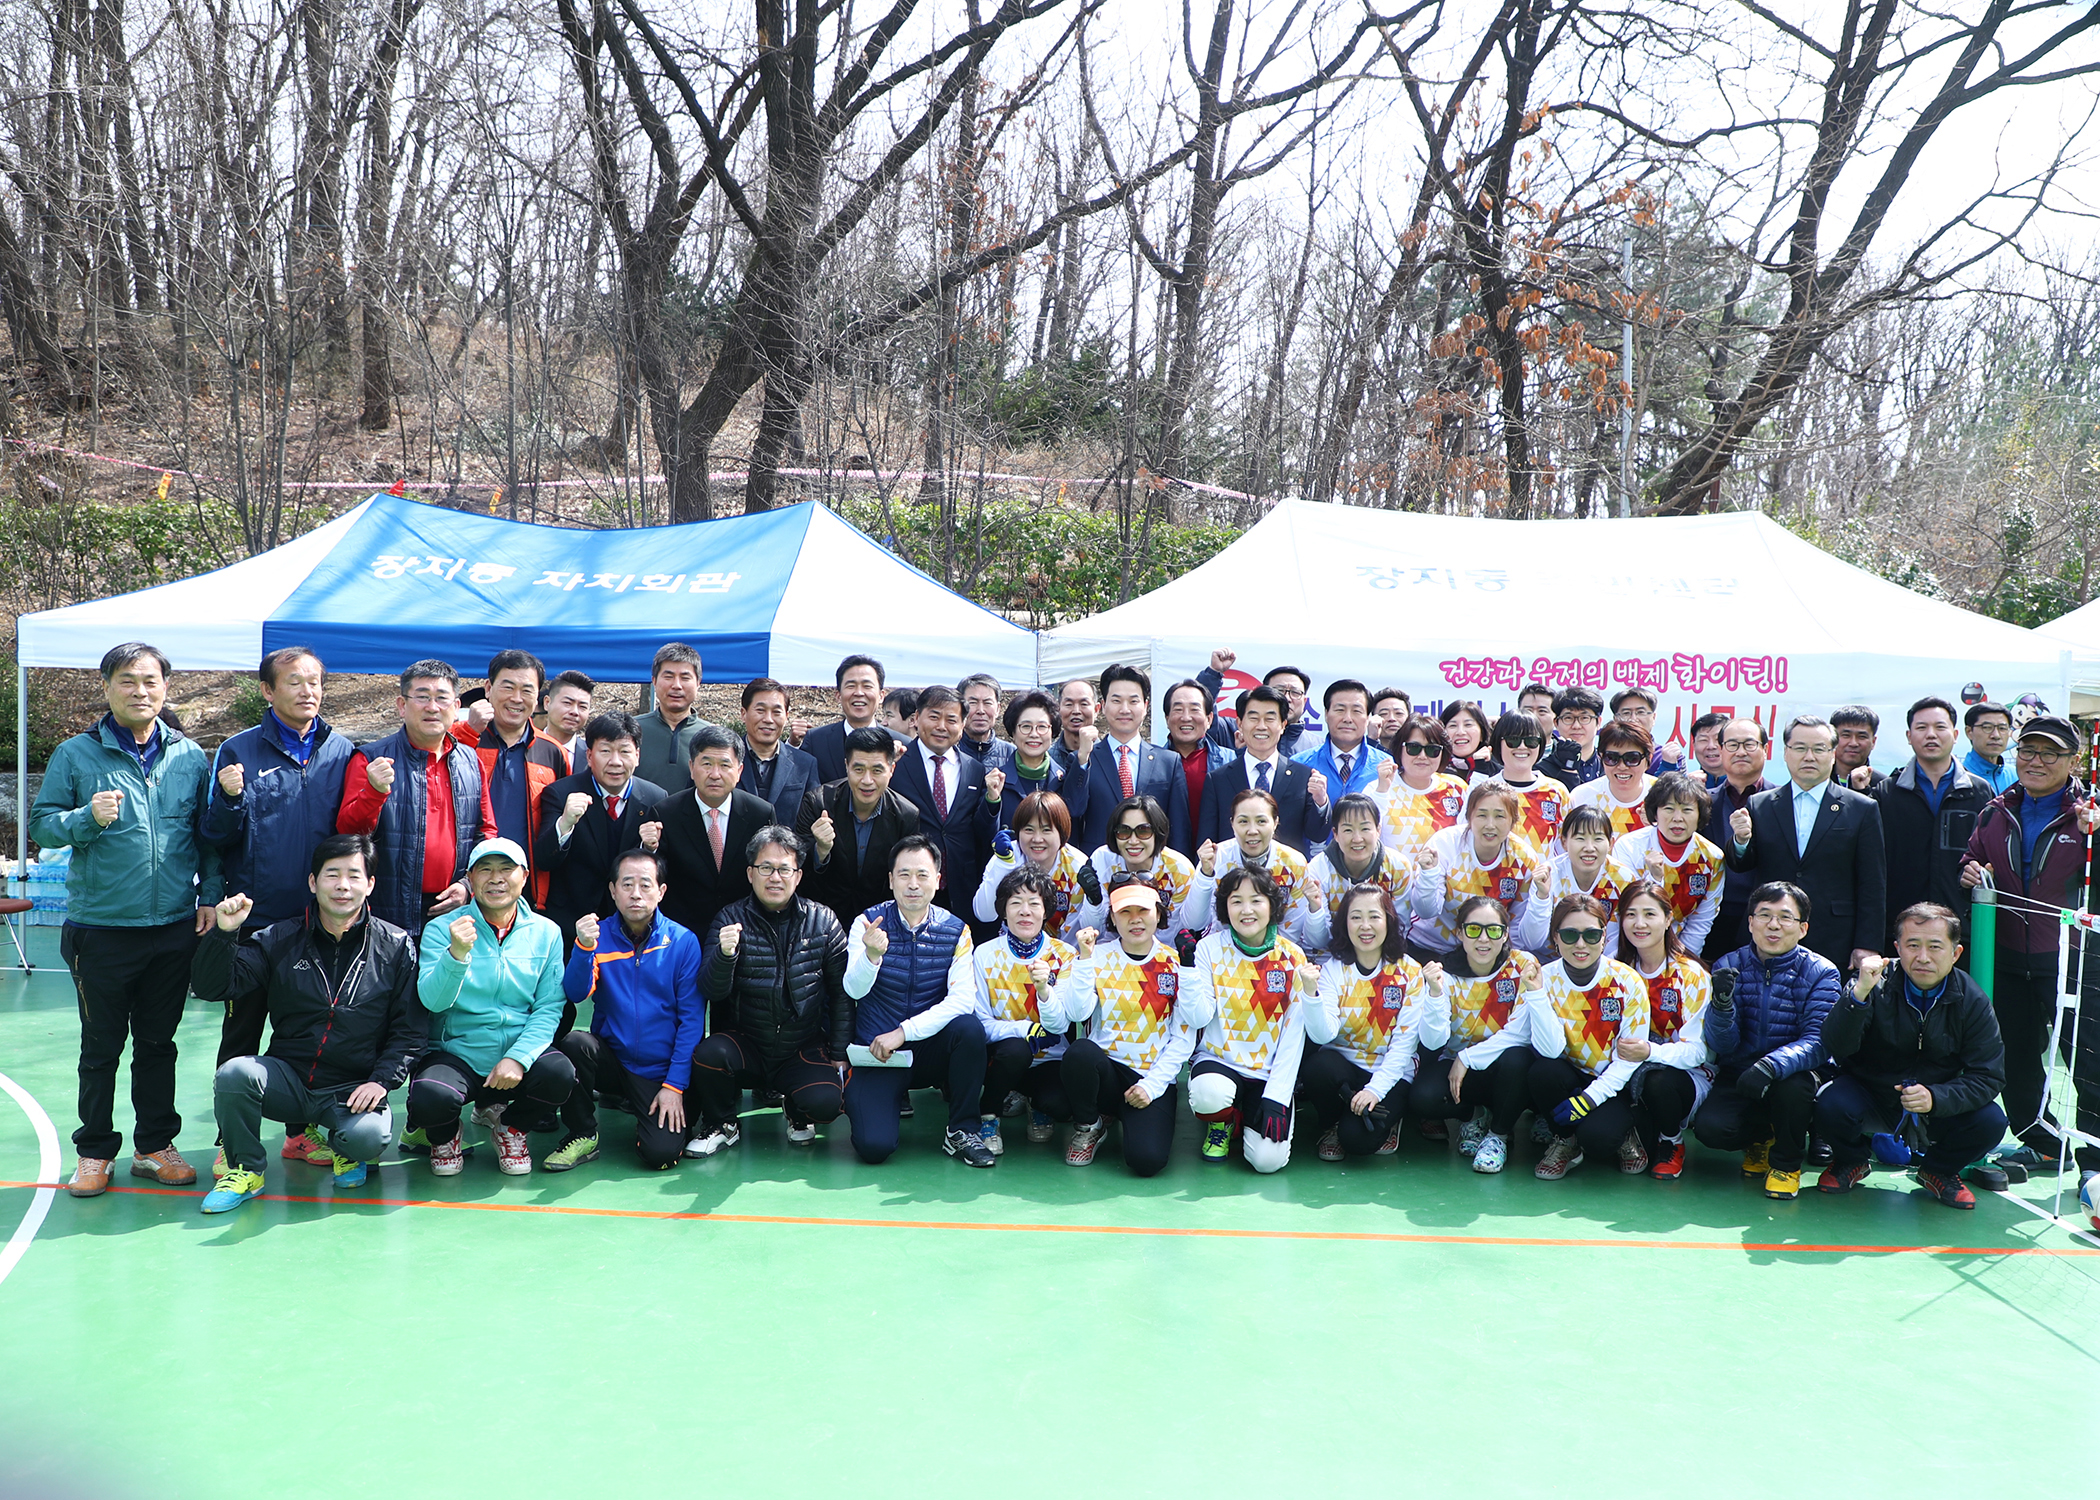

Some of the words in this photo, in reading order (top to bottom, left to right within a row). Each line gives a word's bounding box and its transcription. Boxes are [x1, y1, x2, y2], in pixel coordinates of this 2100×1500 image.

[370, 555, 517, 584] 장지동
[532, 571, 742, 593] 자치회관
[1356, 566, 1511, 592] 장지동
[1439, 656, 1526, 691] 건강과
[1529, 656, 1608, 690] 우정의
[1613, 657, 1668, 693] 백제
[1671, 652, 1788, 693] 화이팅!
